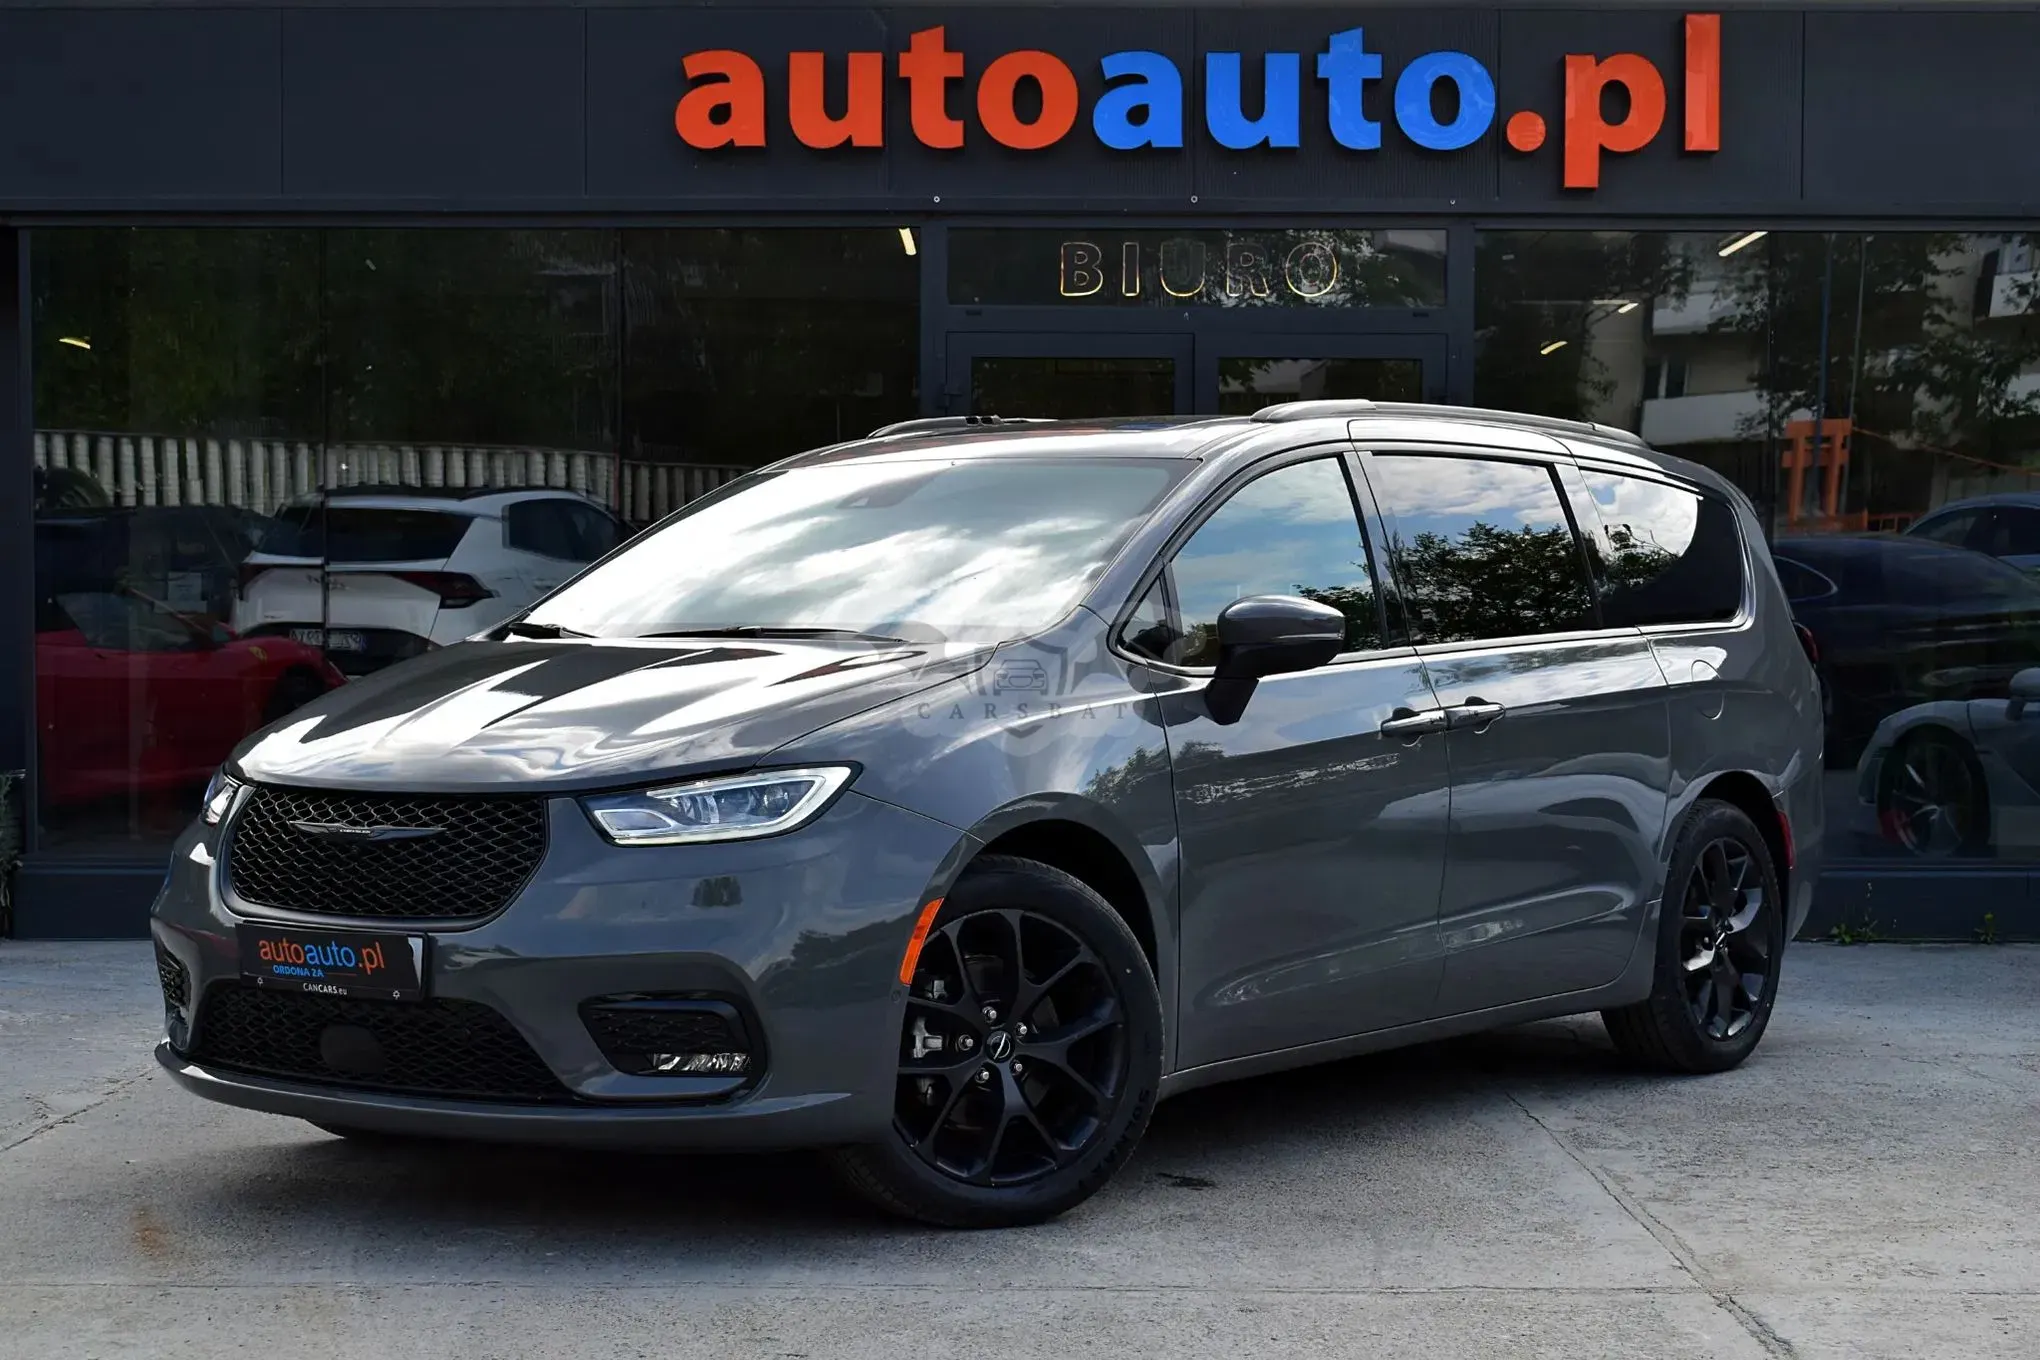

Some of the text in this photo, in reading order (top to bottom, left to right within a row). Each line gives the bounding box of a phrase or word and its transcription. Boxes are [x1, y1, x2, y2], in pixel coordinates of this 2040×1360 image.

[674, 14, 1720, 188] autoauto.pl
[1060, 241, 1337, 297] BIURO
[258, 937, 385, 976] autoauto.pl
[272, 964, 311, 977] ORDONA
[302, 982, 348, 996] CANCARS.eu
